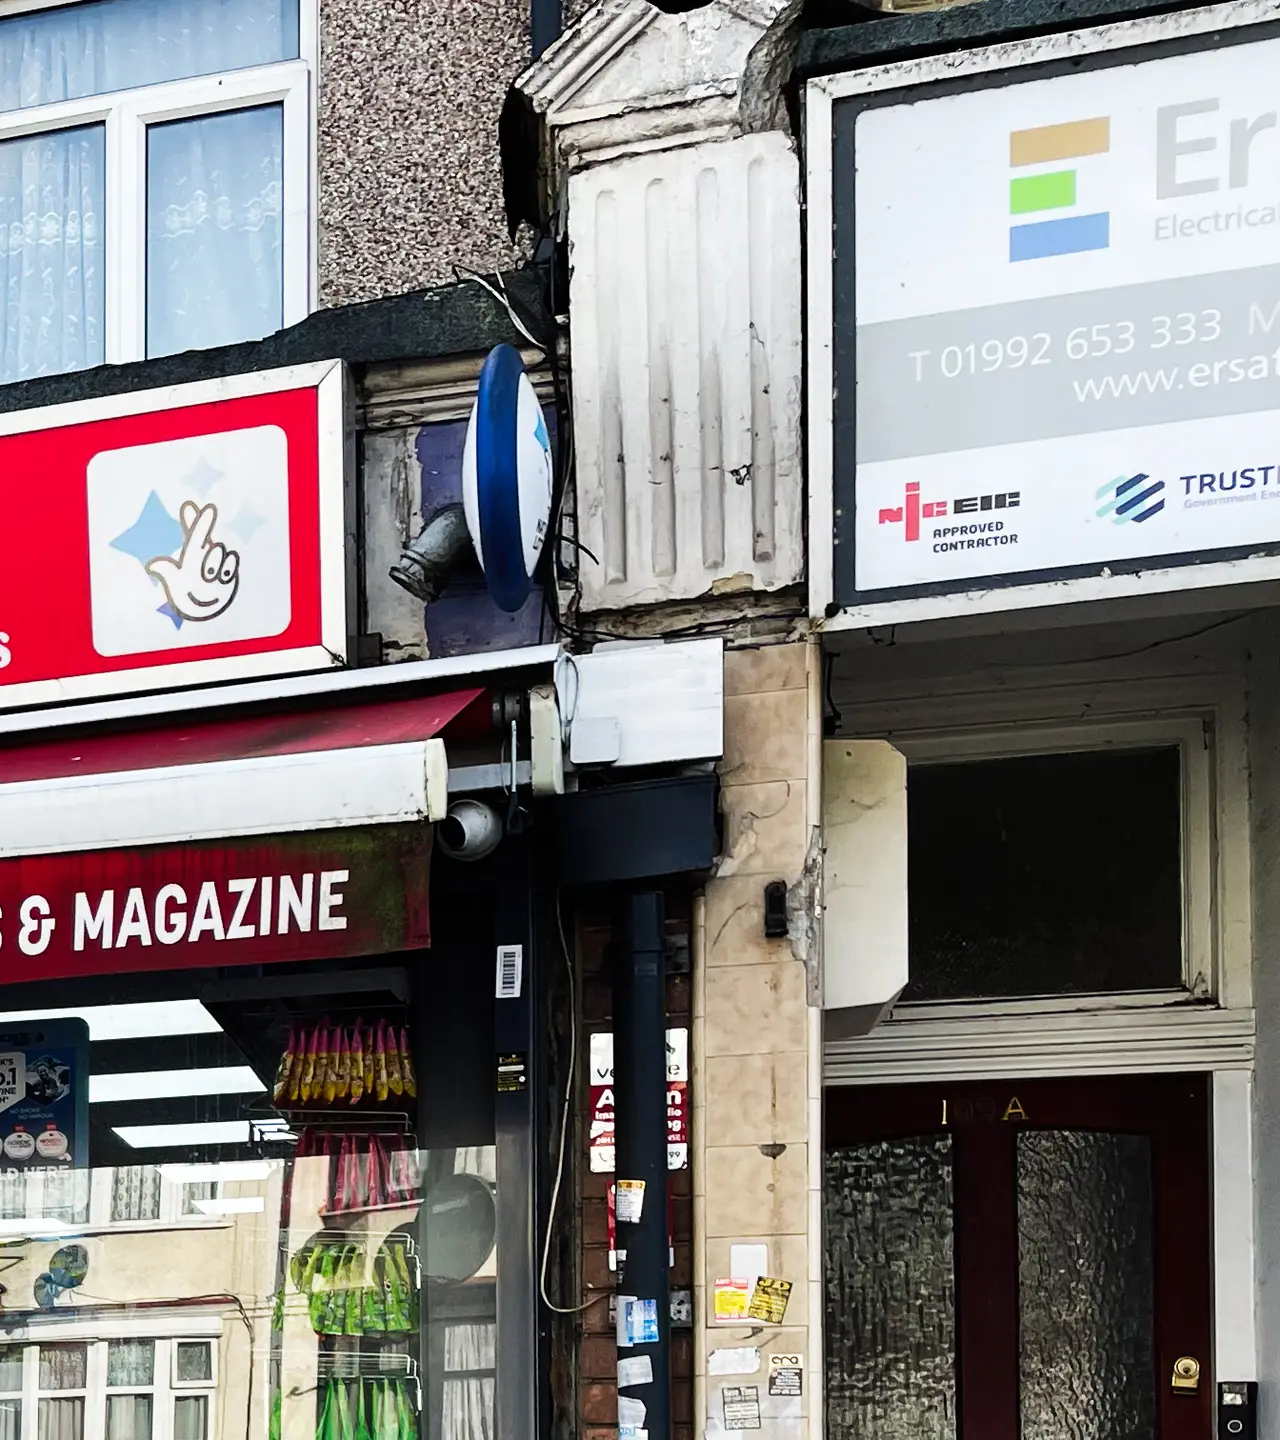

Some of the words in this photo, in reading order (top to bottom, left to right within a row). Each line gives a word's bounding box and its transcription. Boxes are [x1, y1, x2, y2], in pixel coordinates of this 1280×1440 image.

[908, 350, 931, 381] T
[940, 333, 1052, 378] 01992
[1065, 321, 1136, 360] 653
[1149, 309, 1223, 348] 333
[933, 521, 1004, 539] APPROVED
[933, 533, 1018, 553] CONTRACTOR
[17, 894, 56, 956] &
[72, 869, 349, 952] MAGAZINE
